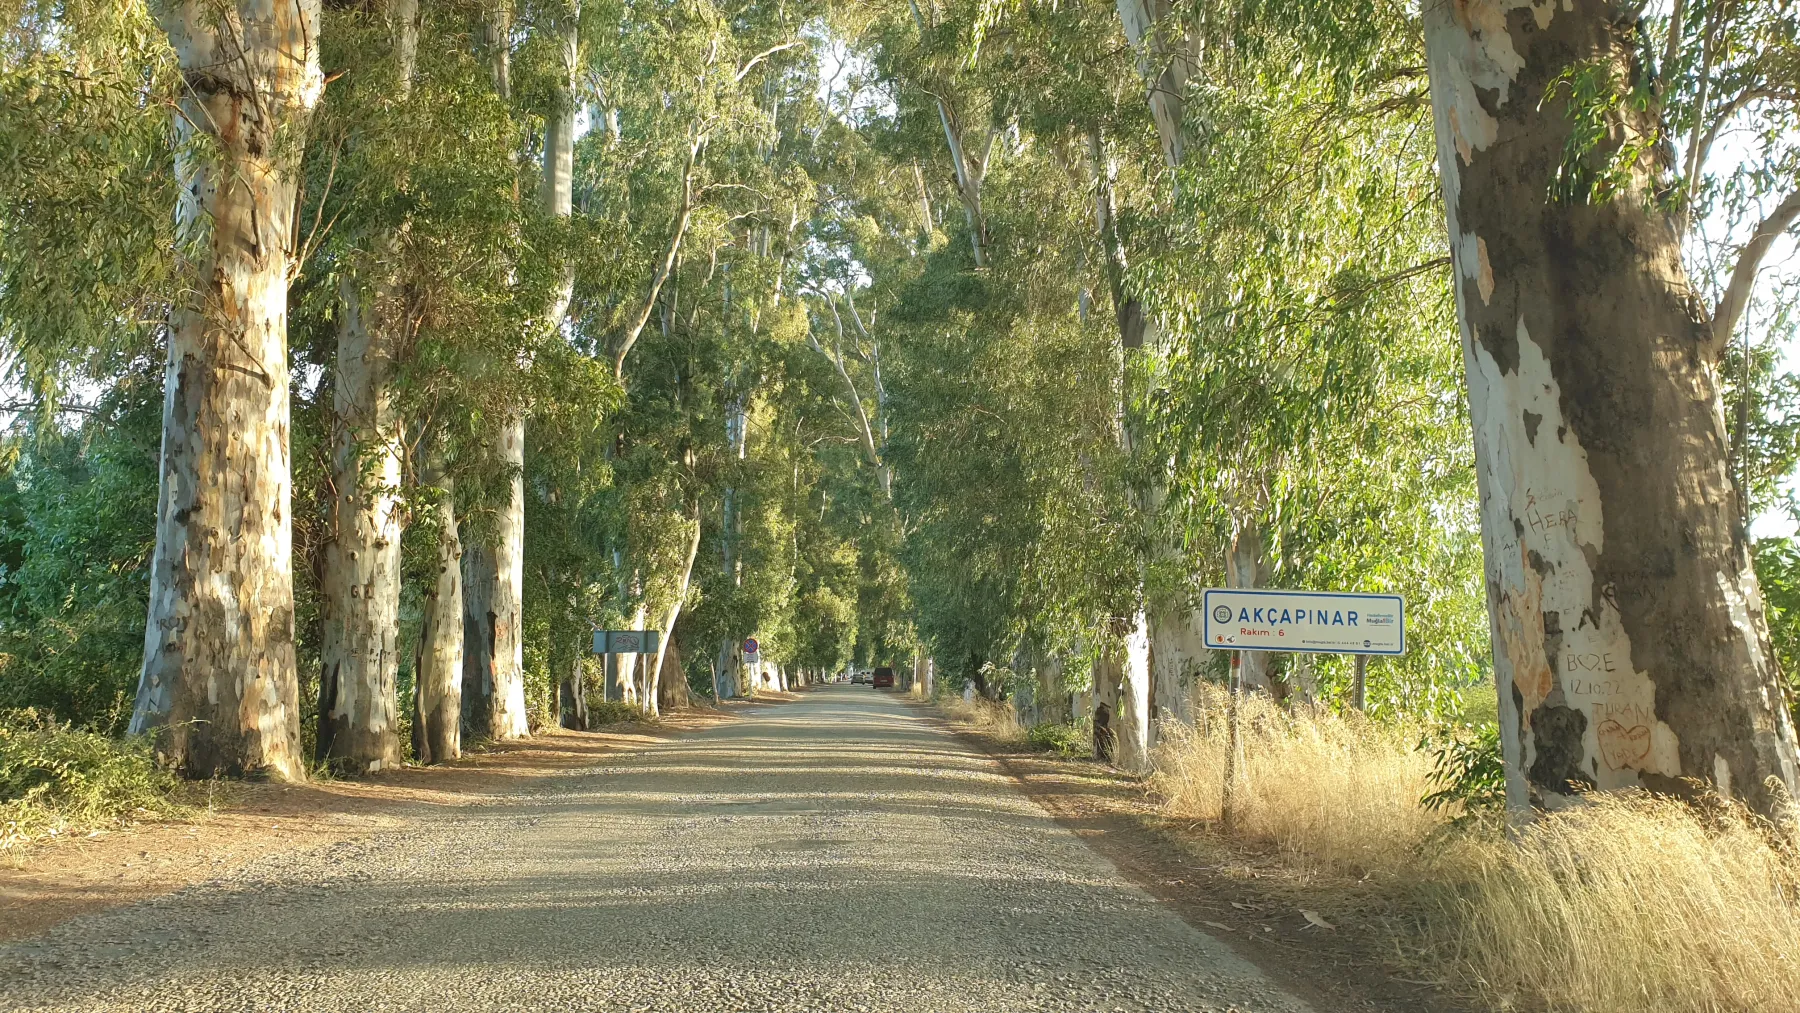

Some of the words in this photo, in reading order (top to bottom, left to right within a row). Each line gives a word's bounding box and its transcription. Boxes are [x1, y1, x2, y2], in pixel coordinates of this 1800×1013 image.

[1238, 607, 1358, 627] AKÇAPINAR
[1240, 628, 1270, 637] Rakım
[1278, 629, 1285, 637] 6
